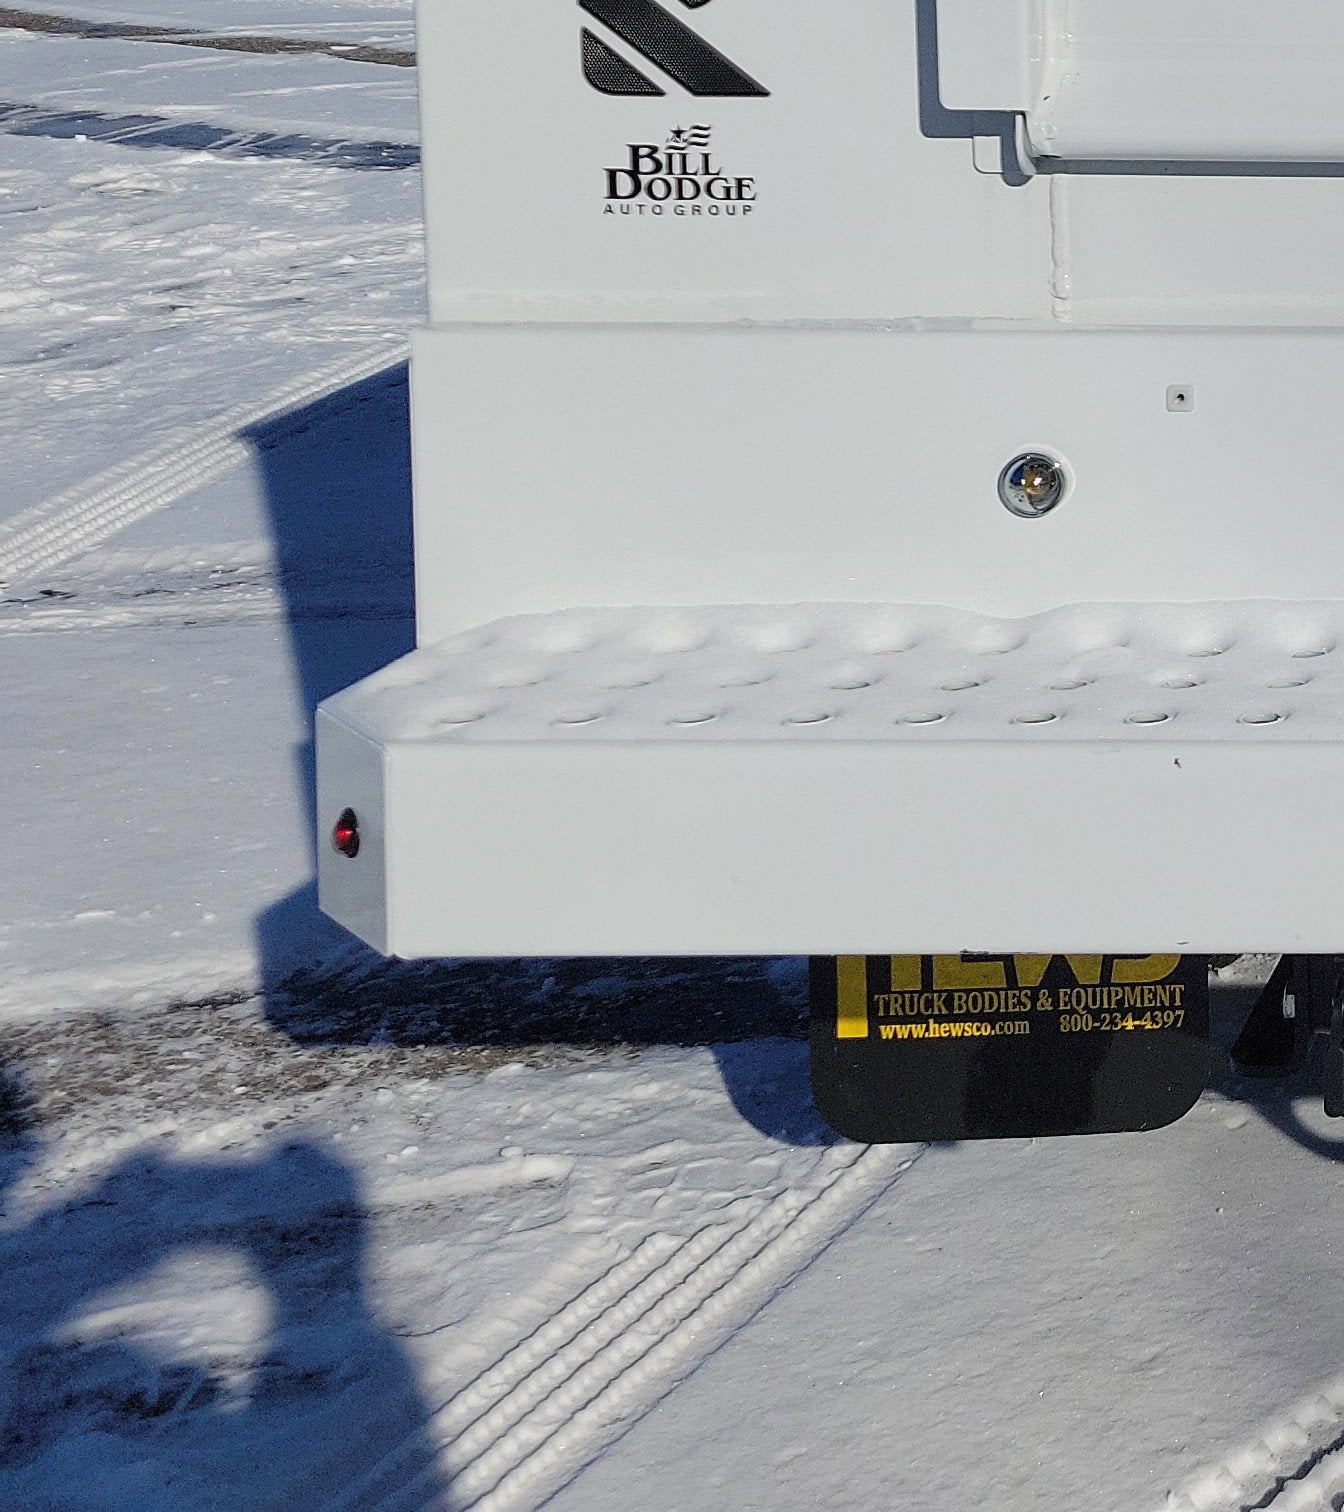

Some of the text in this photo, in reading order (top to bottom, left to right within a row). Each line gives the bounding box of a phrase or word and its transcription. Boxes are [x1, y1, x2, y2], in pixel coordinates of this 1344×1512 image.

[625, 143, 722, 176] BILL
[604, 167, 757, 201] DODGE
[603, 203, 755, 216] AUTO GROUP
[874, 984, 1185, 1017] TRUCK BODIES & EQUIPMENT
[879, 1008, 1185, 1040] www.hewsco.com 800-234-4397
